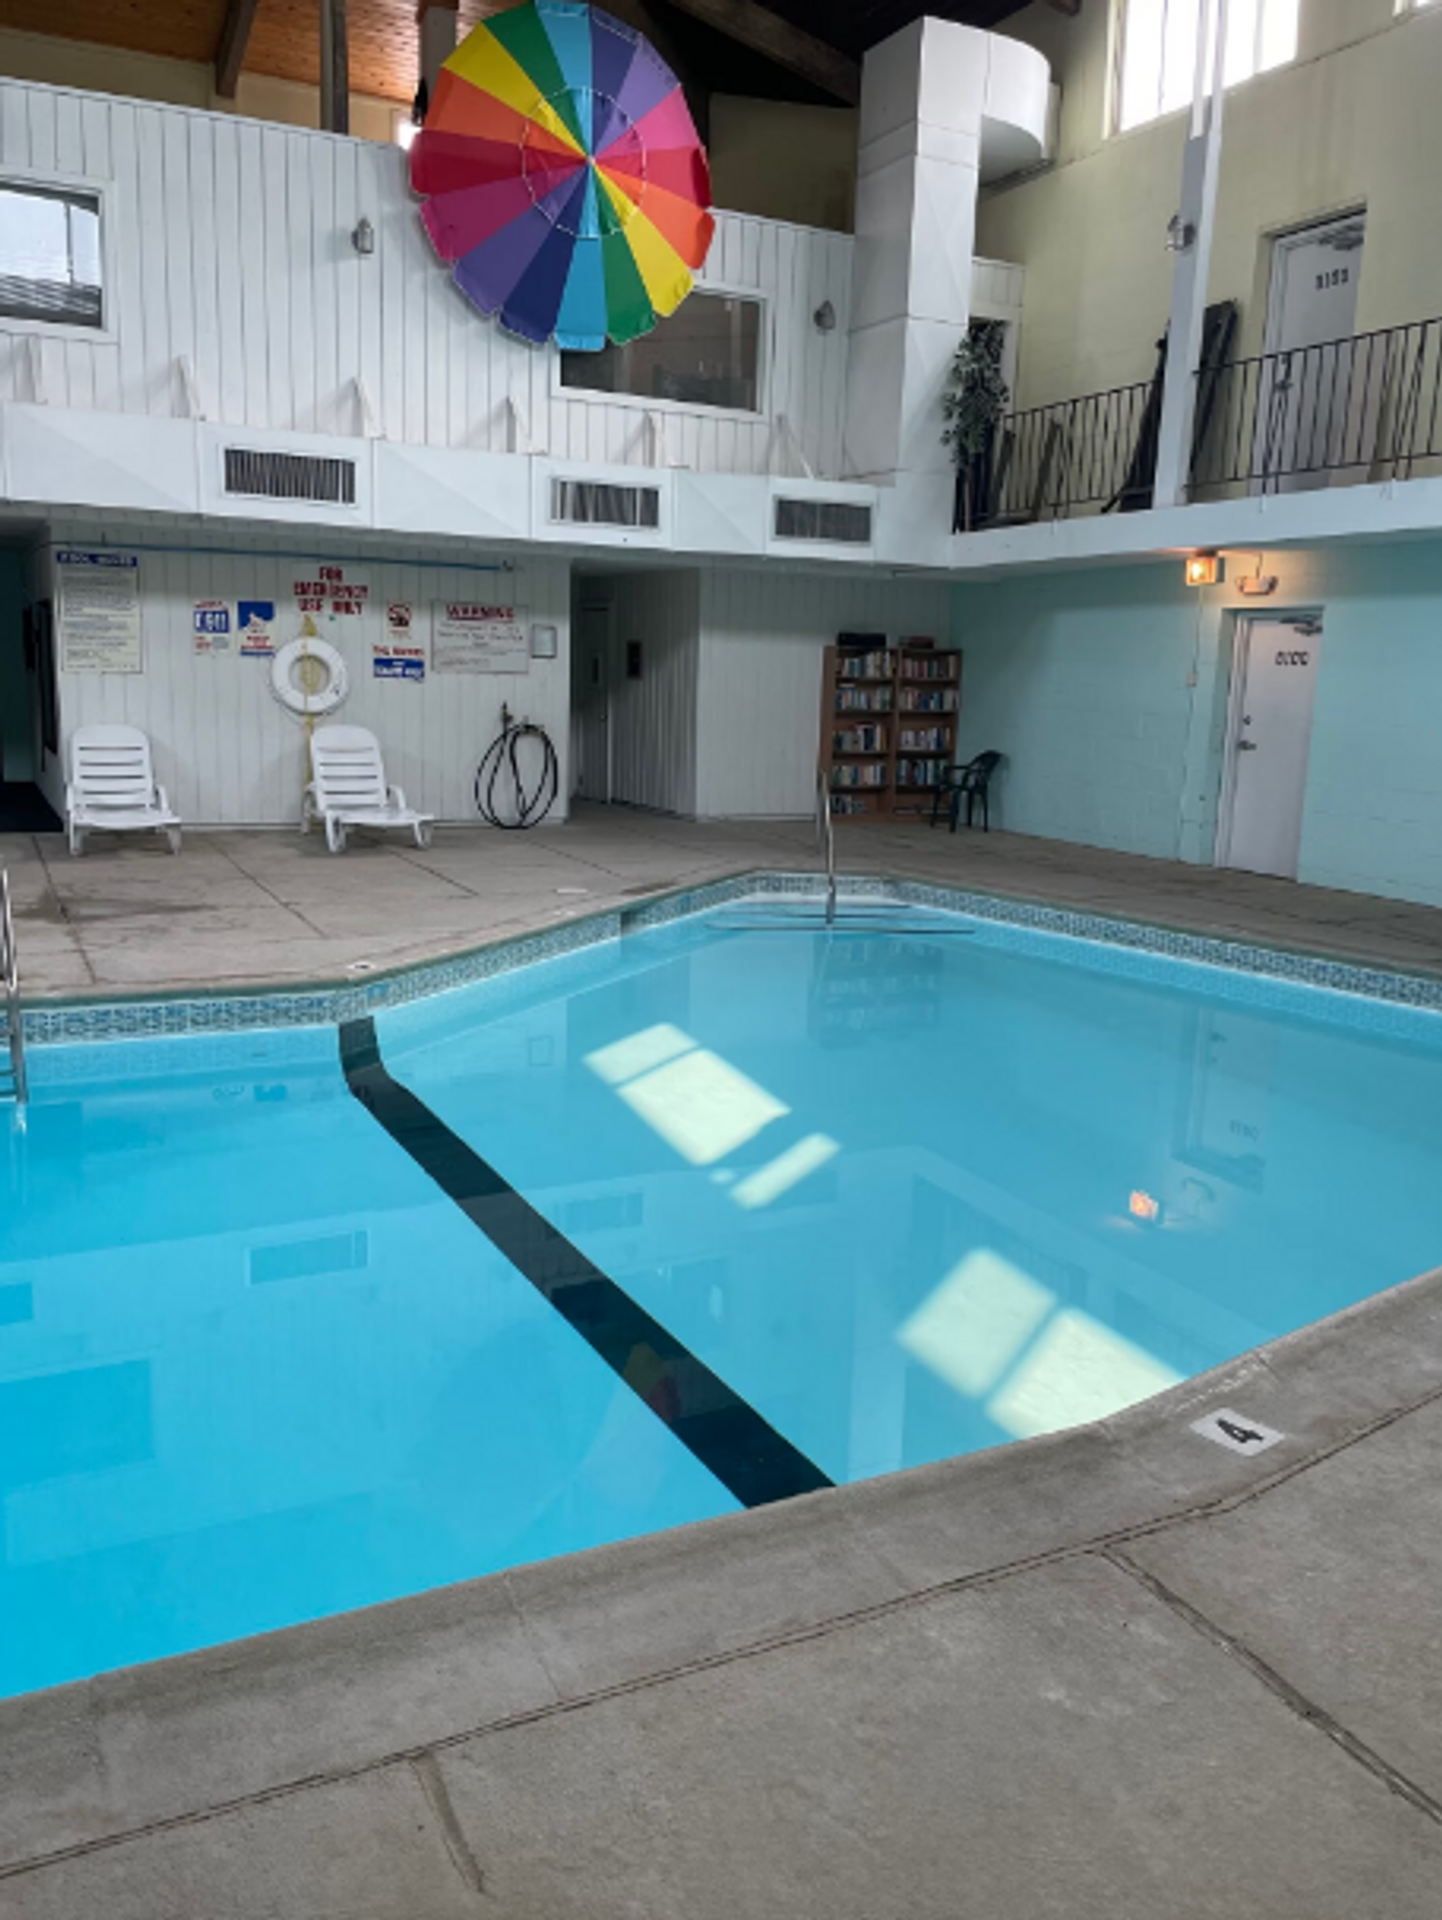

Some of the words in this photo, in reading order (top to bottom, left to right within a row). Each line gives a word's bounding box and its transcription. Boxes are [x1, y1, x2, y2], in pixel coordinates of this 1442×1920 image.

[319, 566, 343, 582] FOR
[294, 582, 368, 599] EMERGENCY
[299, 598, 324, 612] USE
[333, 600, 362, 615] ONLY
[446, 603, 515, 619] WARNING
[1216, 1418, 1264, 1443] 4
